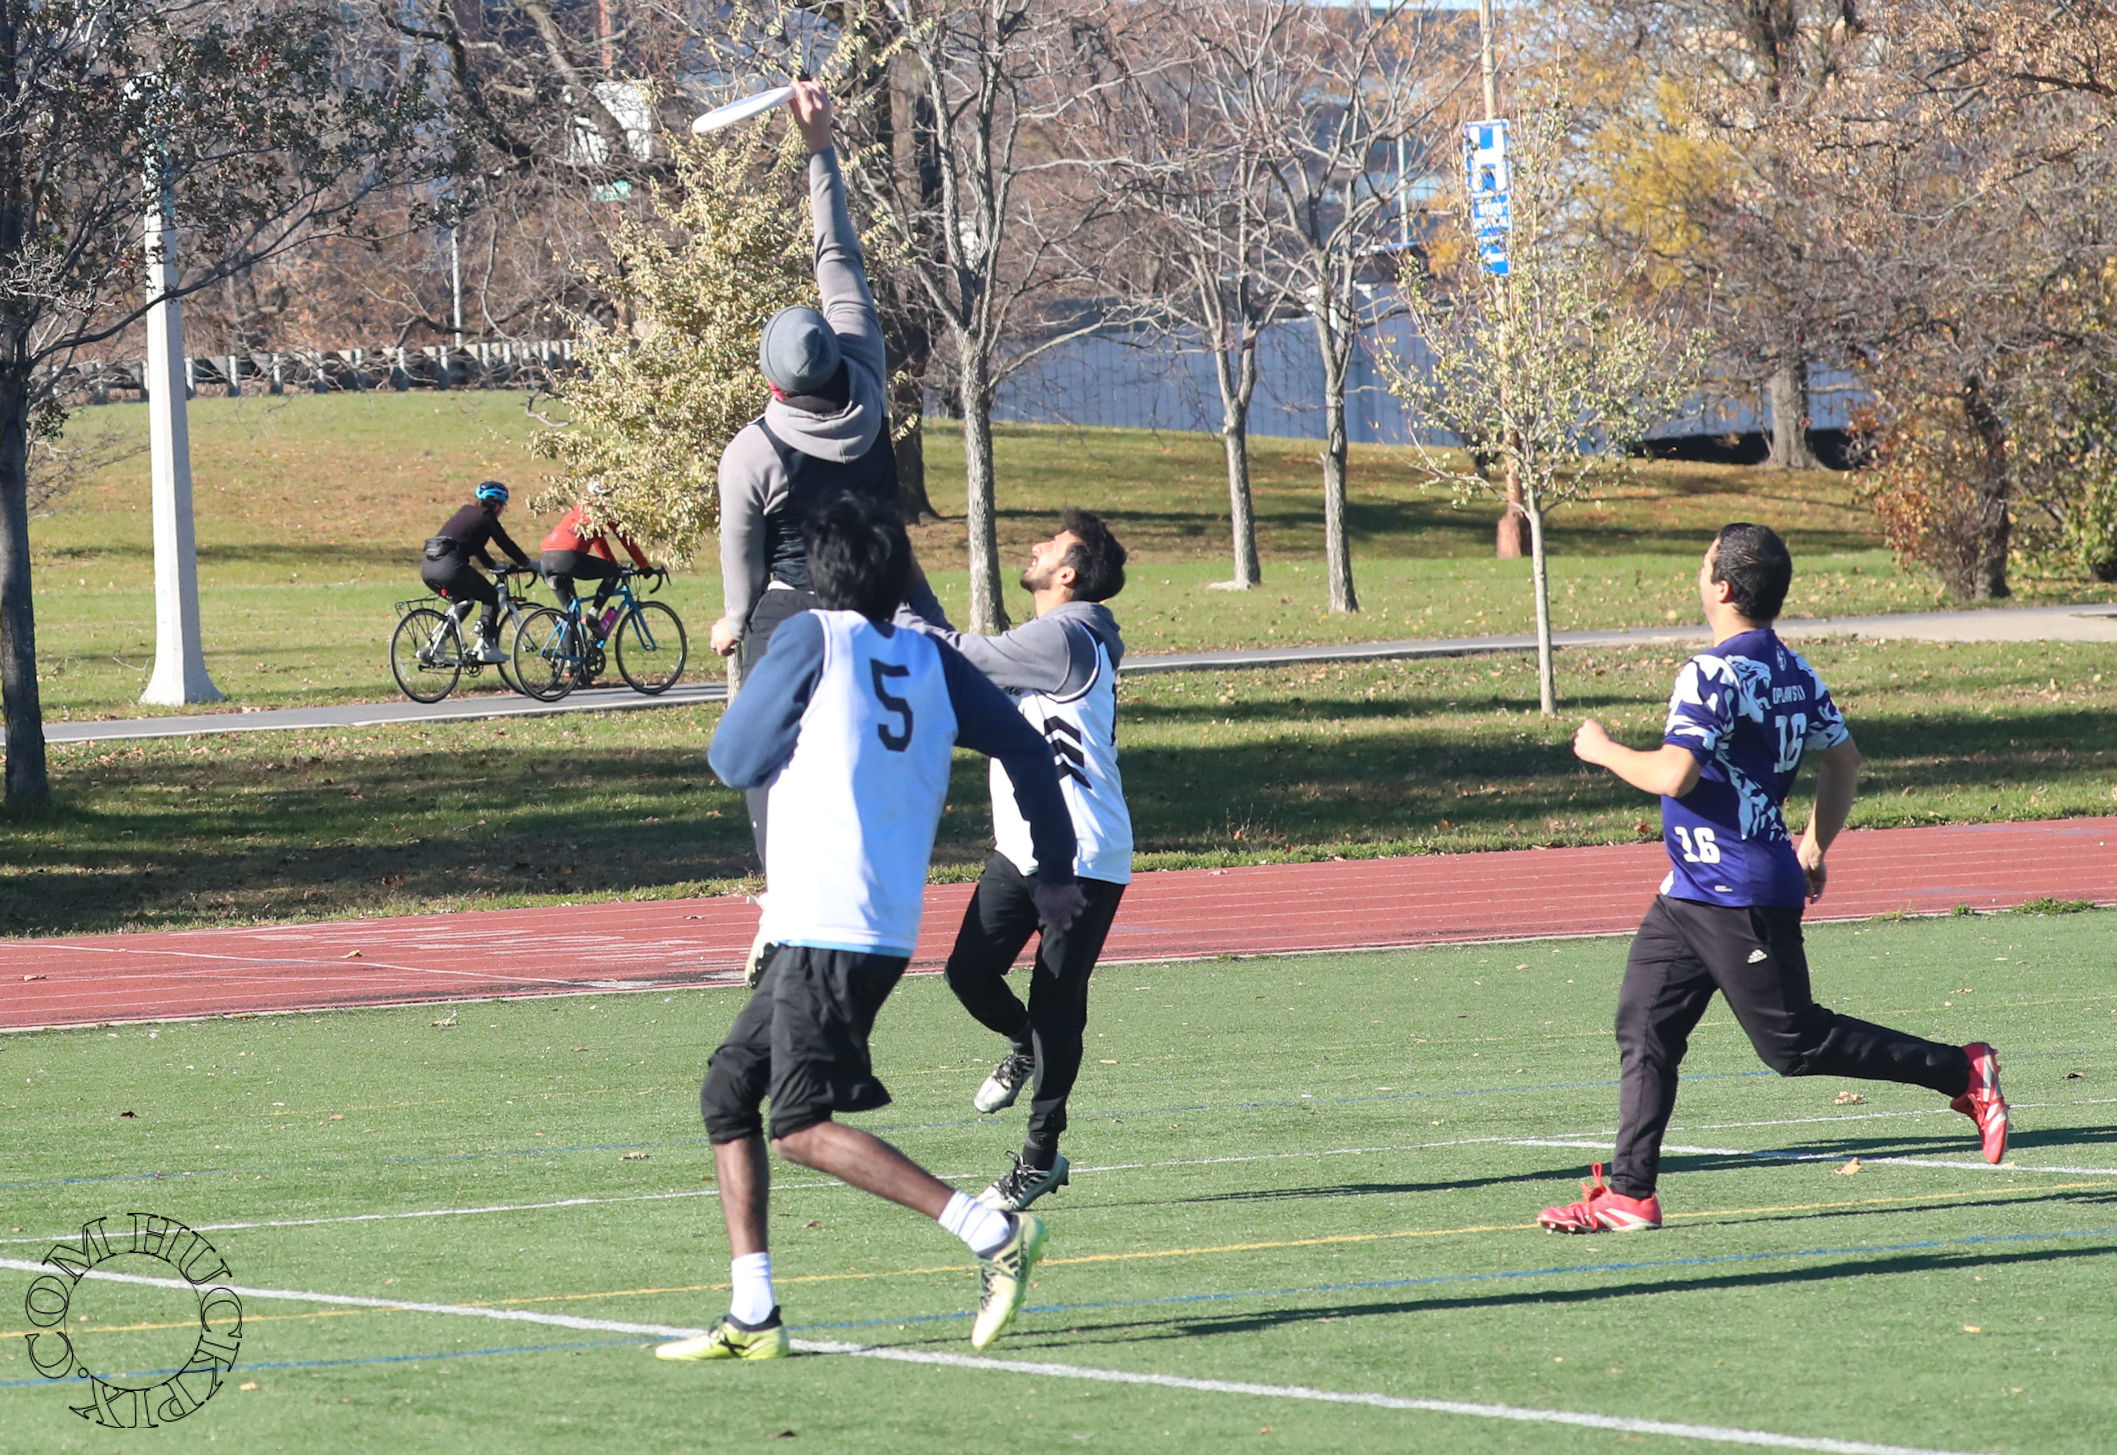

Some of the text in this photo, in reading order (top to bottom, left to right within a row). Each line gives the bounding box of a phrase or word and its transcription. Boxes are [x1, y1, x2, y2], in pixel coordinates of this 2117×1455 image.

[1469, 126, 1507, 192] H
[870, 658, 914, 752] 5
[1774, 713, 1807, 773] 16
[1674, 826, 1721, 864] 16
